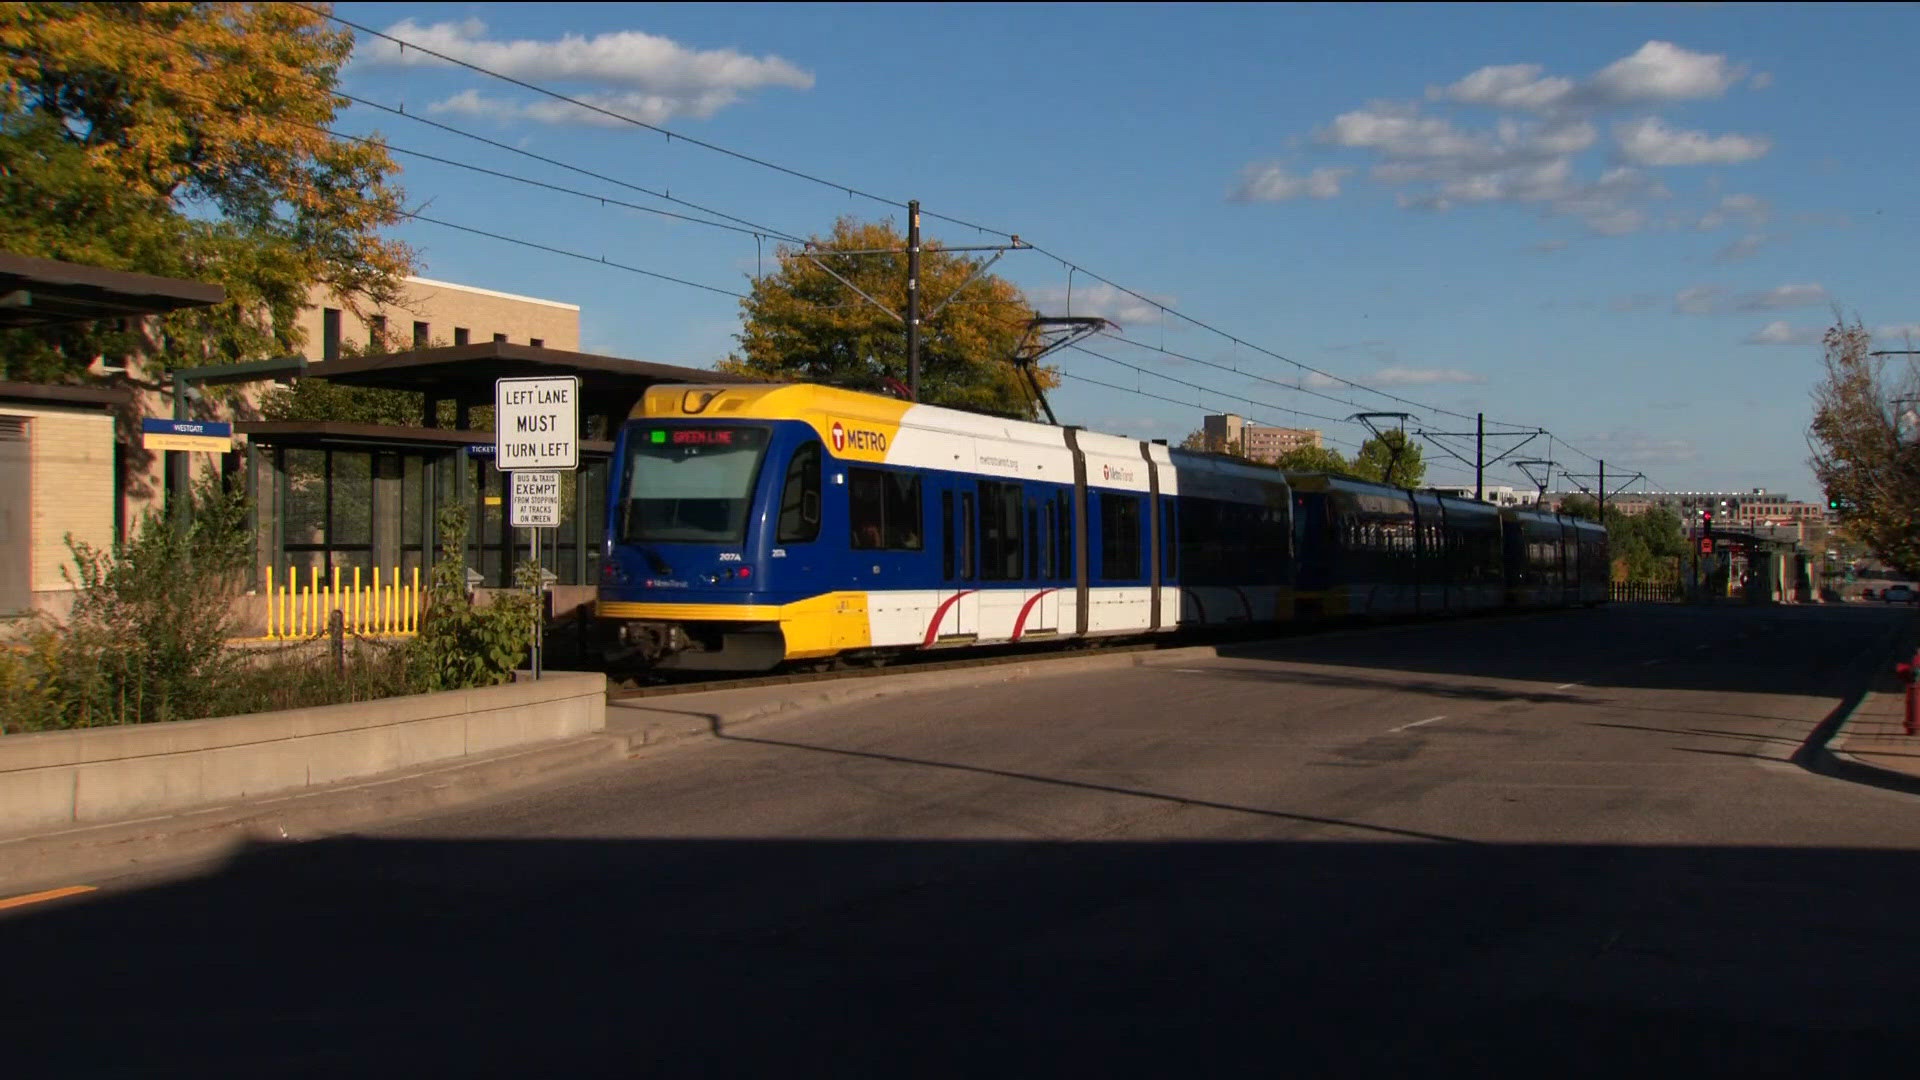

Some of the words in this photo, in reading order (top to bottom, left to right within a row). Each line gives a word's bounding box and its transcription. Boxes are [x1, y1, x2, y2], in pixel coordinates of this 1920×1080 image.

[506, 391, 533, 404] LEFT
[538, 389, 568, 404] LANE
[174, 424, 203, 433] WESTGATE
[517, 415, 556, 432] MUST
[847, 429, 886, 452] METRO
[506, 444, 536, 457] TURN
[541, 443, 569, 456] LEFT
[516, 484, 556, 495] EXEMPT
[531, 496, 558, 504] STOPPING
[520, 506, 527, 514] AT
[529, 505, 552, 514] TRACKS
[720, 553, 741, 561] 207A
